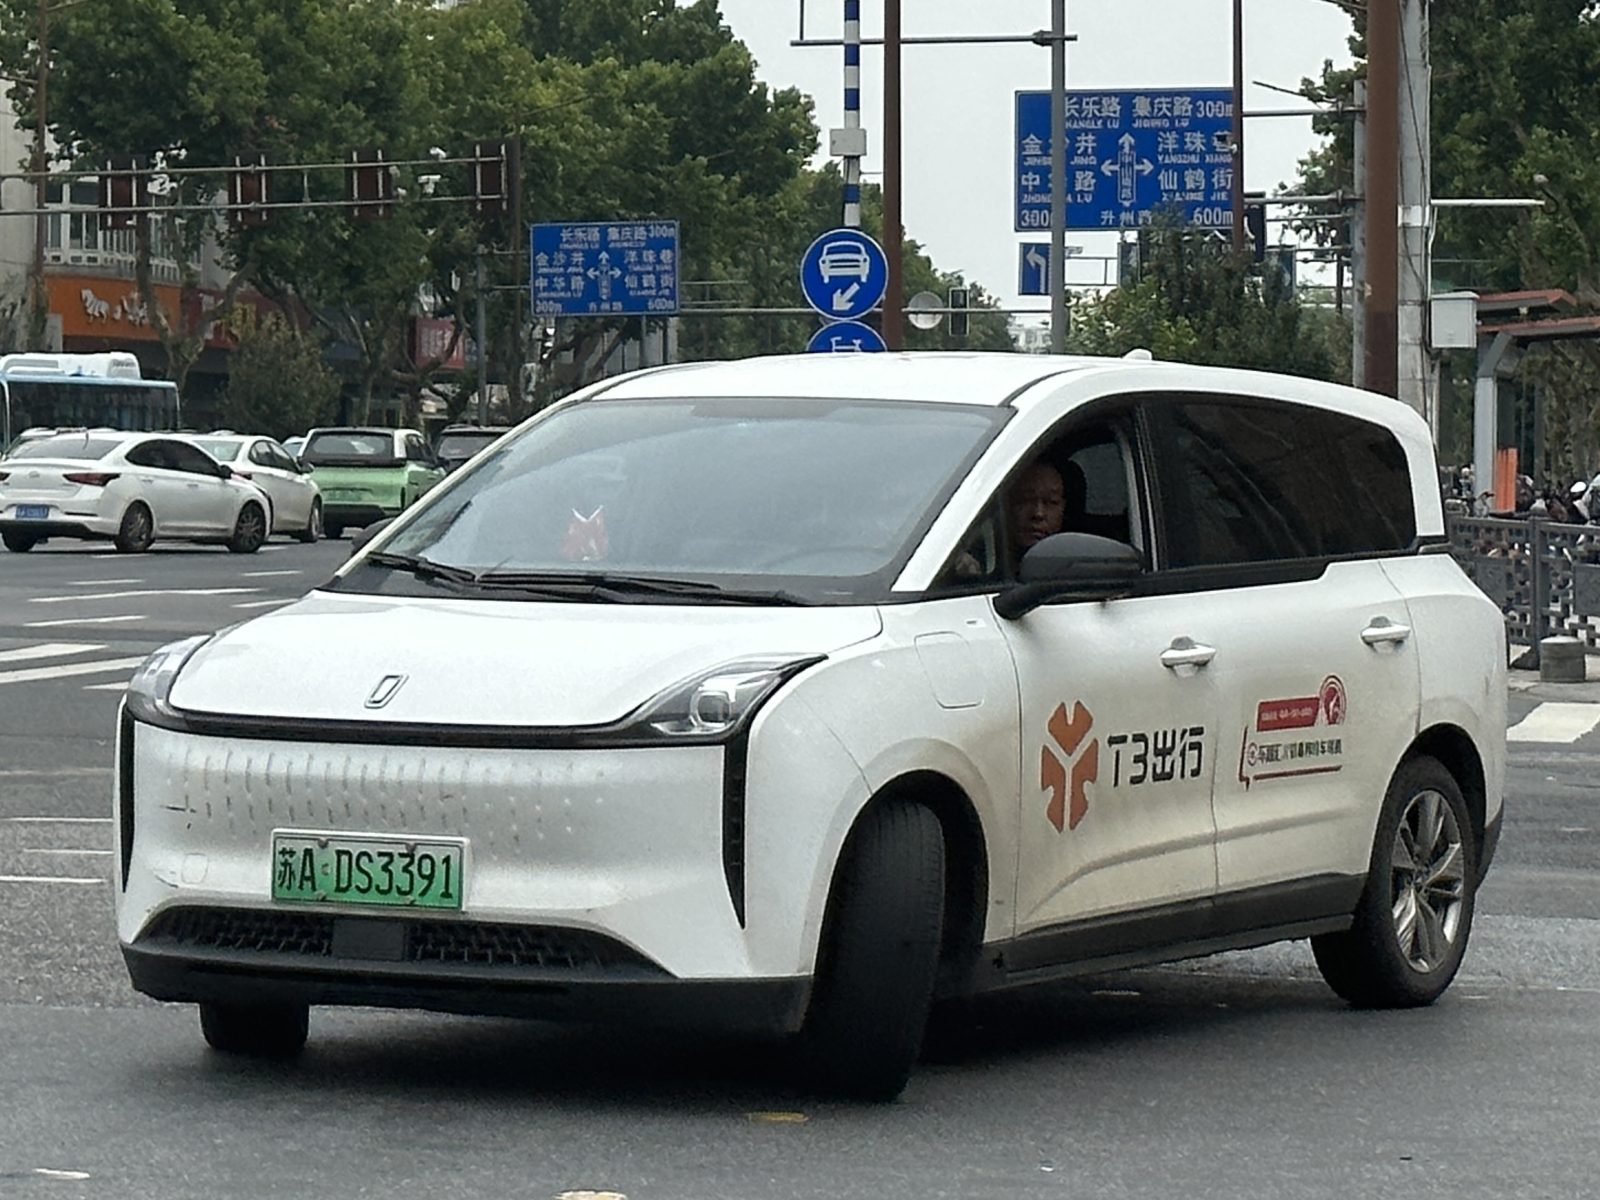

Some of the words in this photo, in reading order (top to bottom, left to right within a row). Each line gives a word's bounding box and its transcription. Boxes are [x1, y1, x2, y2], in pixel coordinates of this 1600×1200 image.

[1065, 97, 1121, 117] 长乐路
[1132, 97, 1192, 117] 集庆路
[1022, 133, 1097, 154] 金井
[1021, 169, 1097, 192] 中路
[1158, 168, 1233, 190] 仙鹤街
[1107, 726, 1204, 788] T3出行
